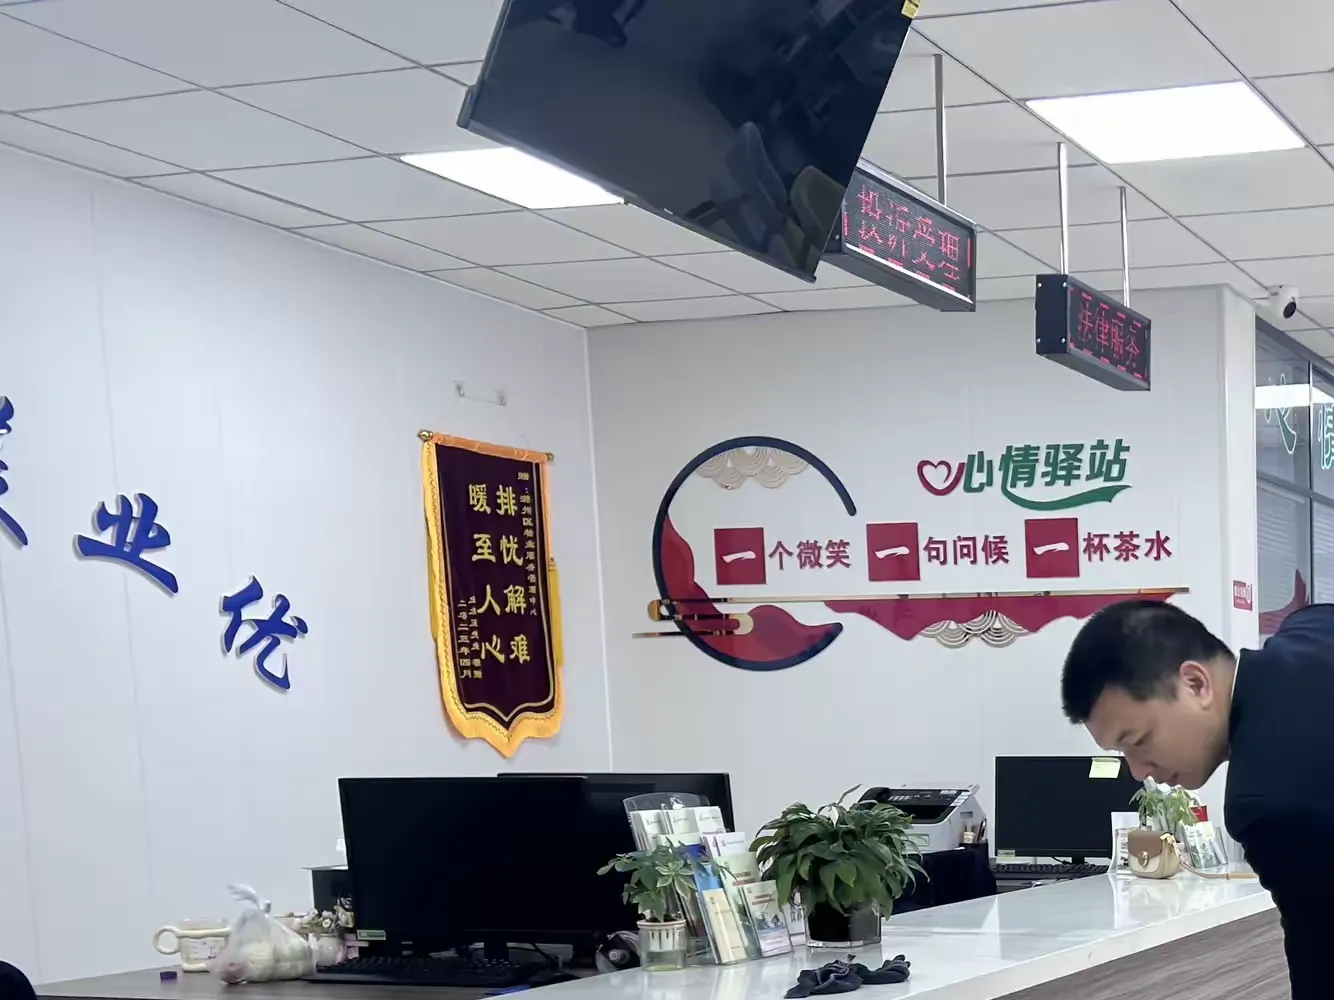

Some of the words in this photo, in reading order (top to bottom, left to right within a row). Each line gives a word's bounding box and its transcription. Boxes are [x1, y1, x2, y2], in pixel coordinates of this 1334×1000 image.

[961, 438, 1131, 493] 心情驿站
[468, 483, 505, 664] 暖至人心
[495, 484, 531, 664] 排忧解难
[721, 538, 853, 571] 一个微笑
[873, 534, 1011, 567] 一句问候
[1032, 529, 1174, 563] 一杯茶水
